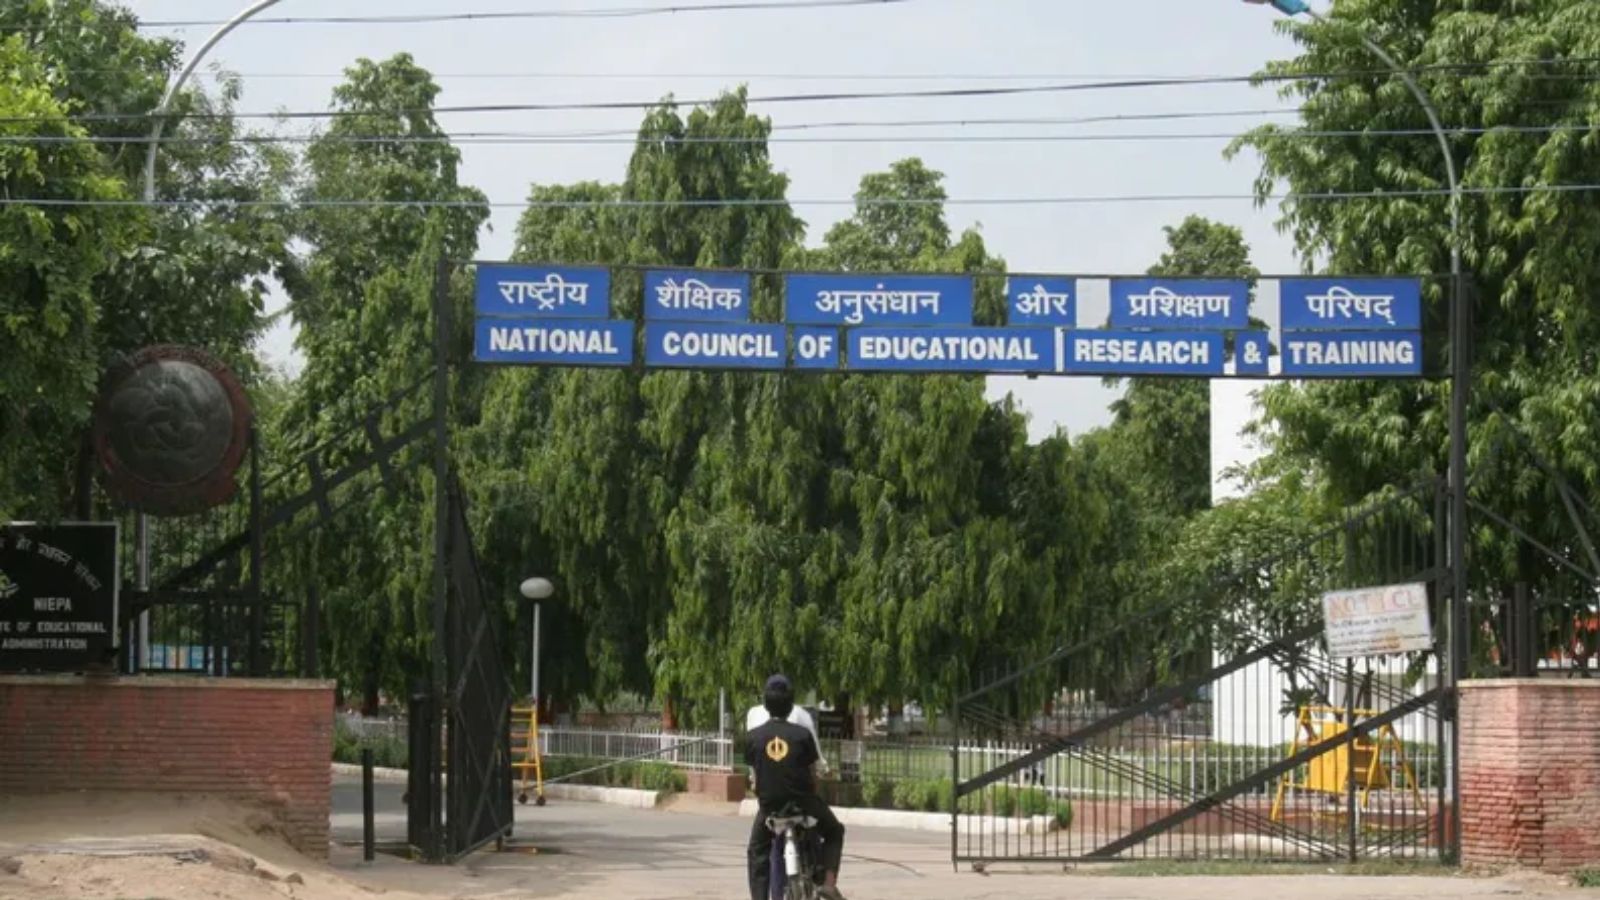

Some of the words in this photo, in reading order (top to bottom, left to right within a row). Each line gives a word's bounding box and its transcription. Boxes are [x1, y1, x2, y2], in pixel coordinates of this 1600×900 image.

[498, 273, 589, 311] राष्ट्रीय
[656, 279, 741, 309] शैक्षिक
[816, 284, 939, 323] अनुसंधान
[1016, 285, 1068, 314] और
[1128, 287, 1230, 317] प्रशिक्षण
[1306, 287, 1394, 324] परिषद्
[491, 328, 617, 353] NATIONAL
[663, 332, 778, 357] COUNCIL
[799, 335, 832, 358] OF
[860, 337, 1038, 360] EDUCATIONAL
[1075, 339, 1208, 363] RESEARCH
[1244, 341, 1261, 363] &
[1289, 341, 1413, 364] TRAINING
[33, 597, 72, 611] NIEPA
[16, 621, 31, 633] OF
[37, 621, 107, 633] EDUCATIONAL
[2, 637, 88, 649] ADMINISTRATION
